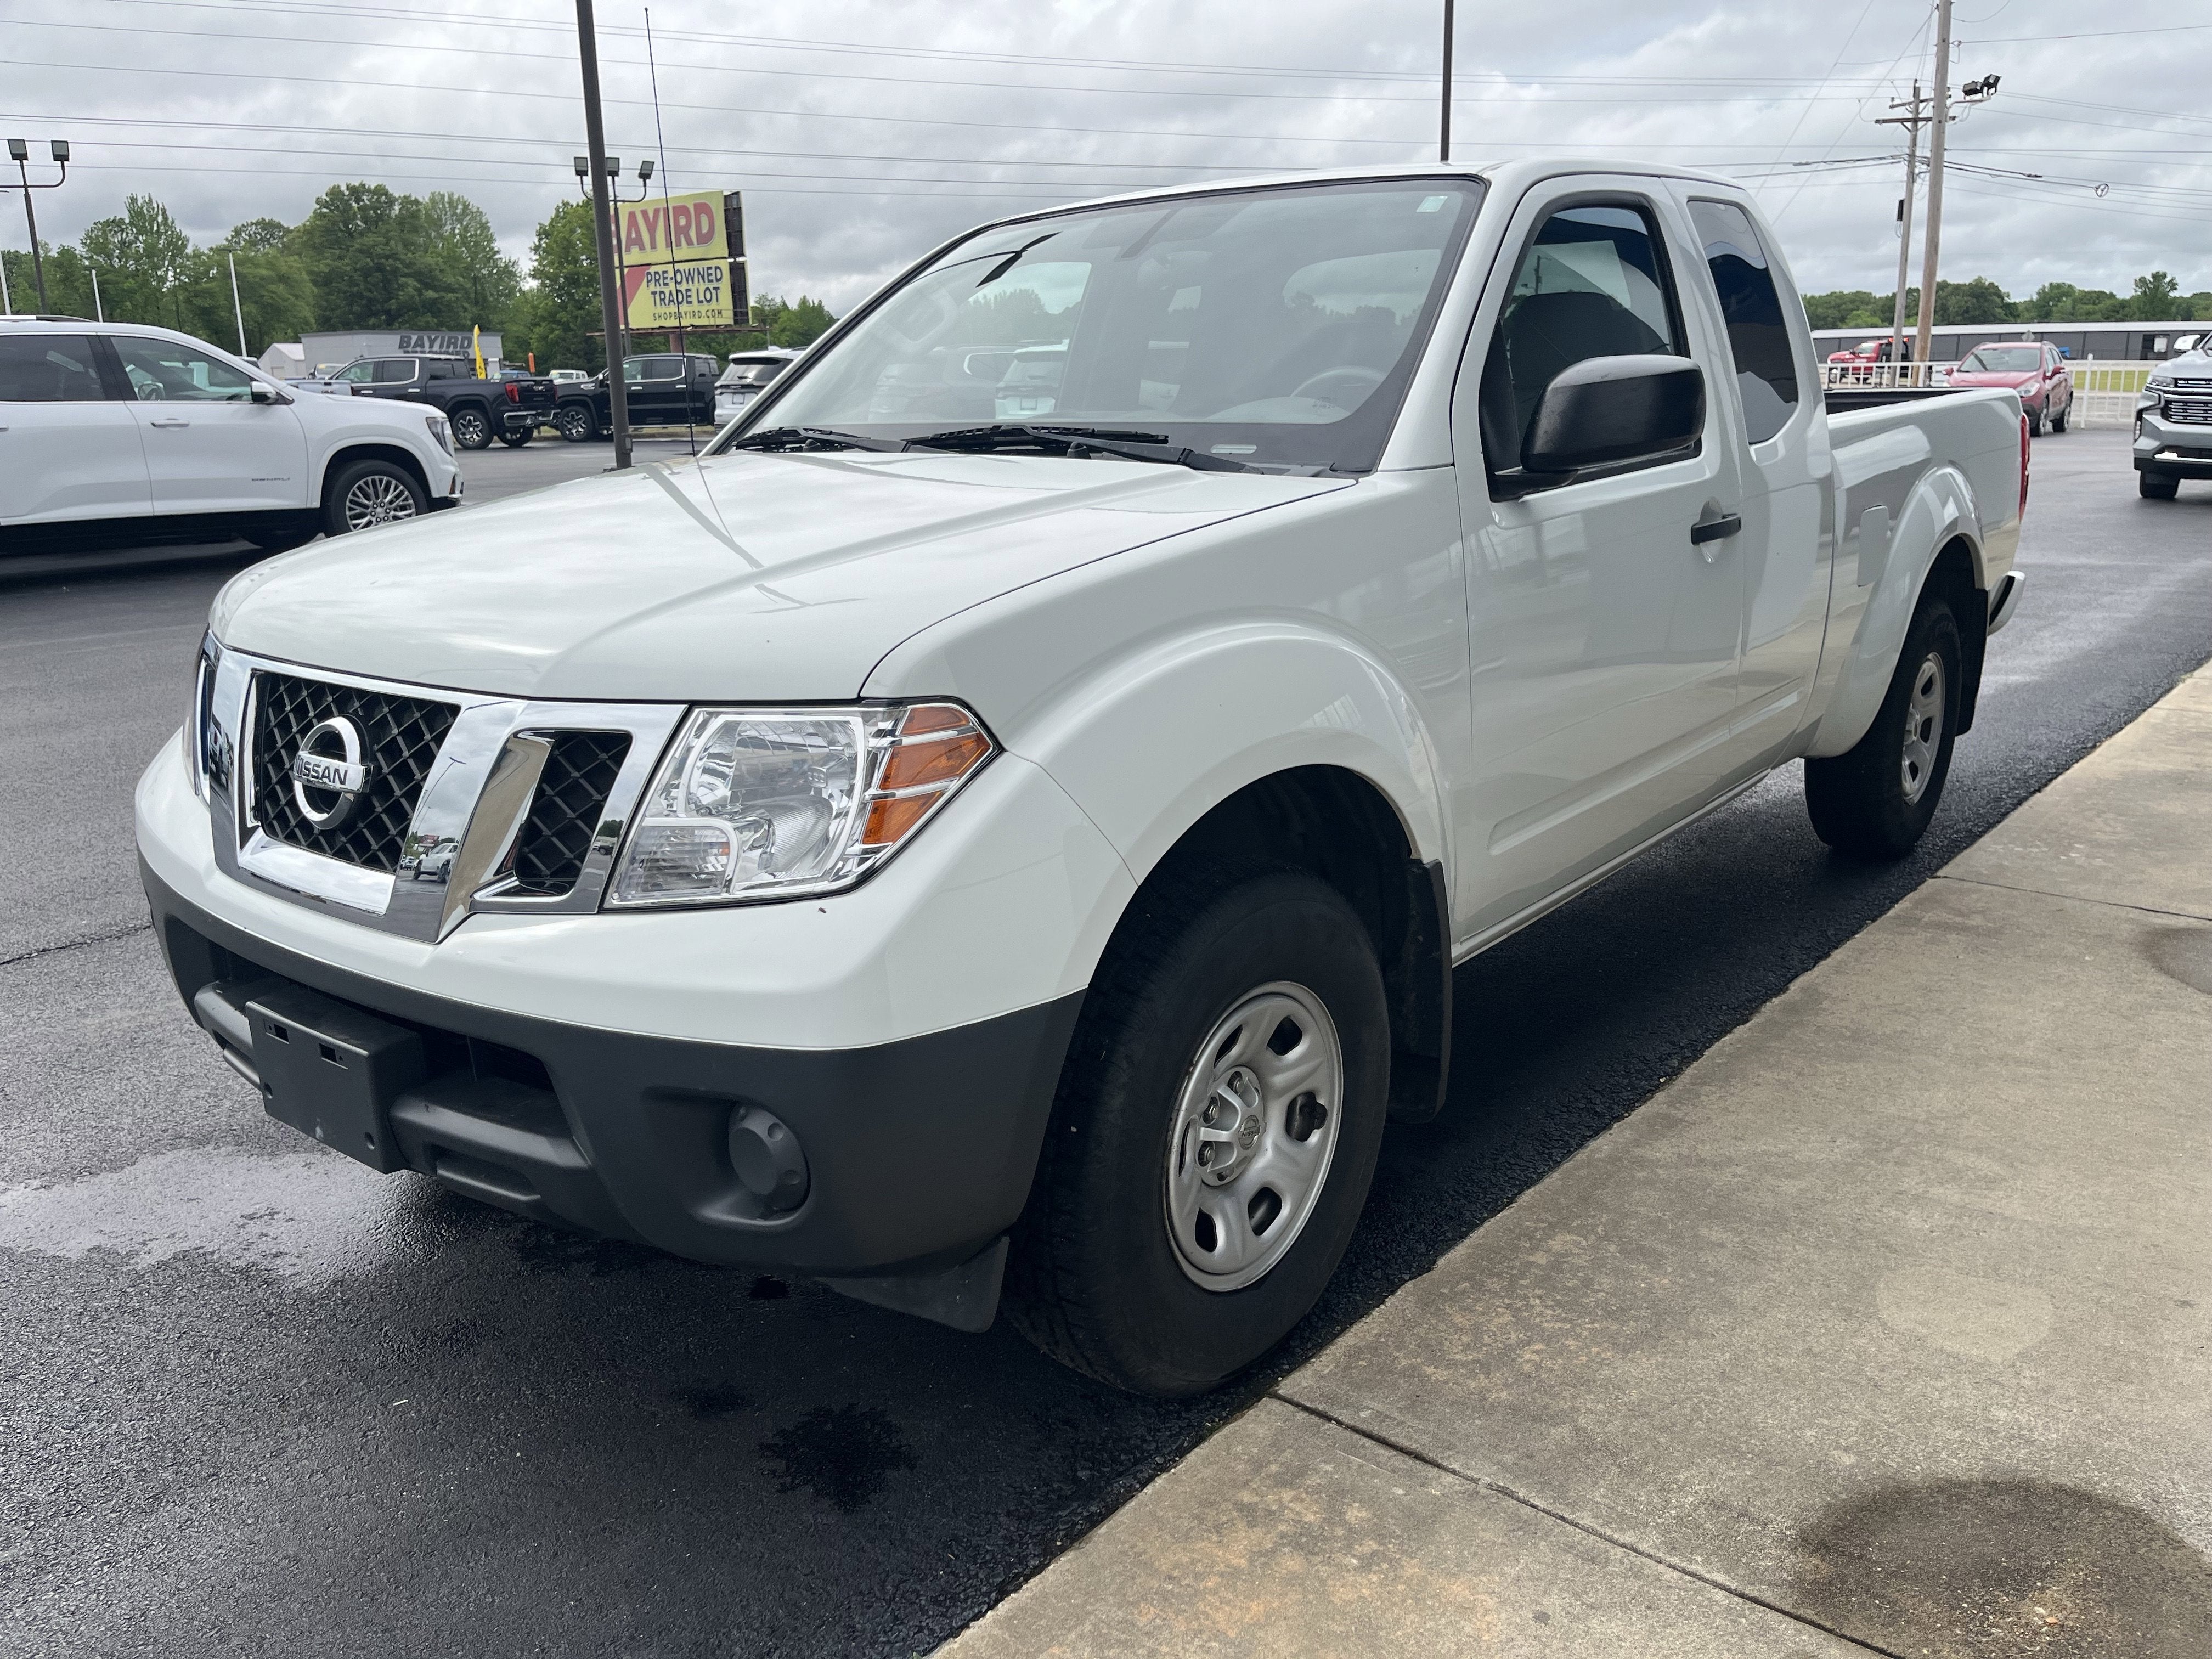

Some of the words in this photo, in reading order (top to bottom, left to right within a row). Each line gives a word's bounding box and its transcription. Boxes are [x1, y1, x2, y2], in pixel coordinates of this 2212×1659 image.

[646, 266, 723, 288] PRE-OWNED
[651, 288, 692, 307] TRADE
[696, 286, 720, 304] LOT
[398, 335, 473, 349] BAYIRD
[296, 754, 348, 786] NISSAN
